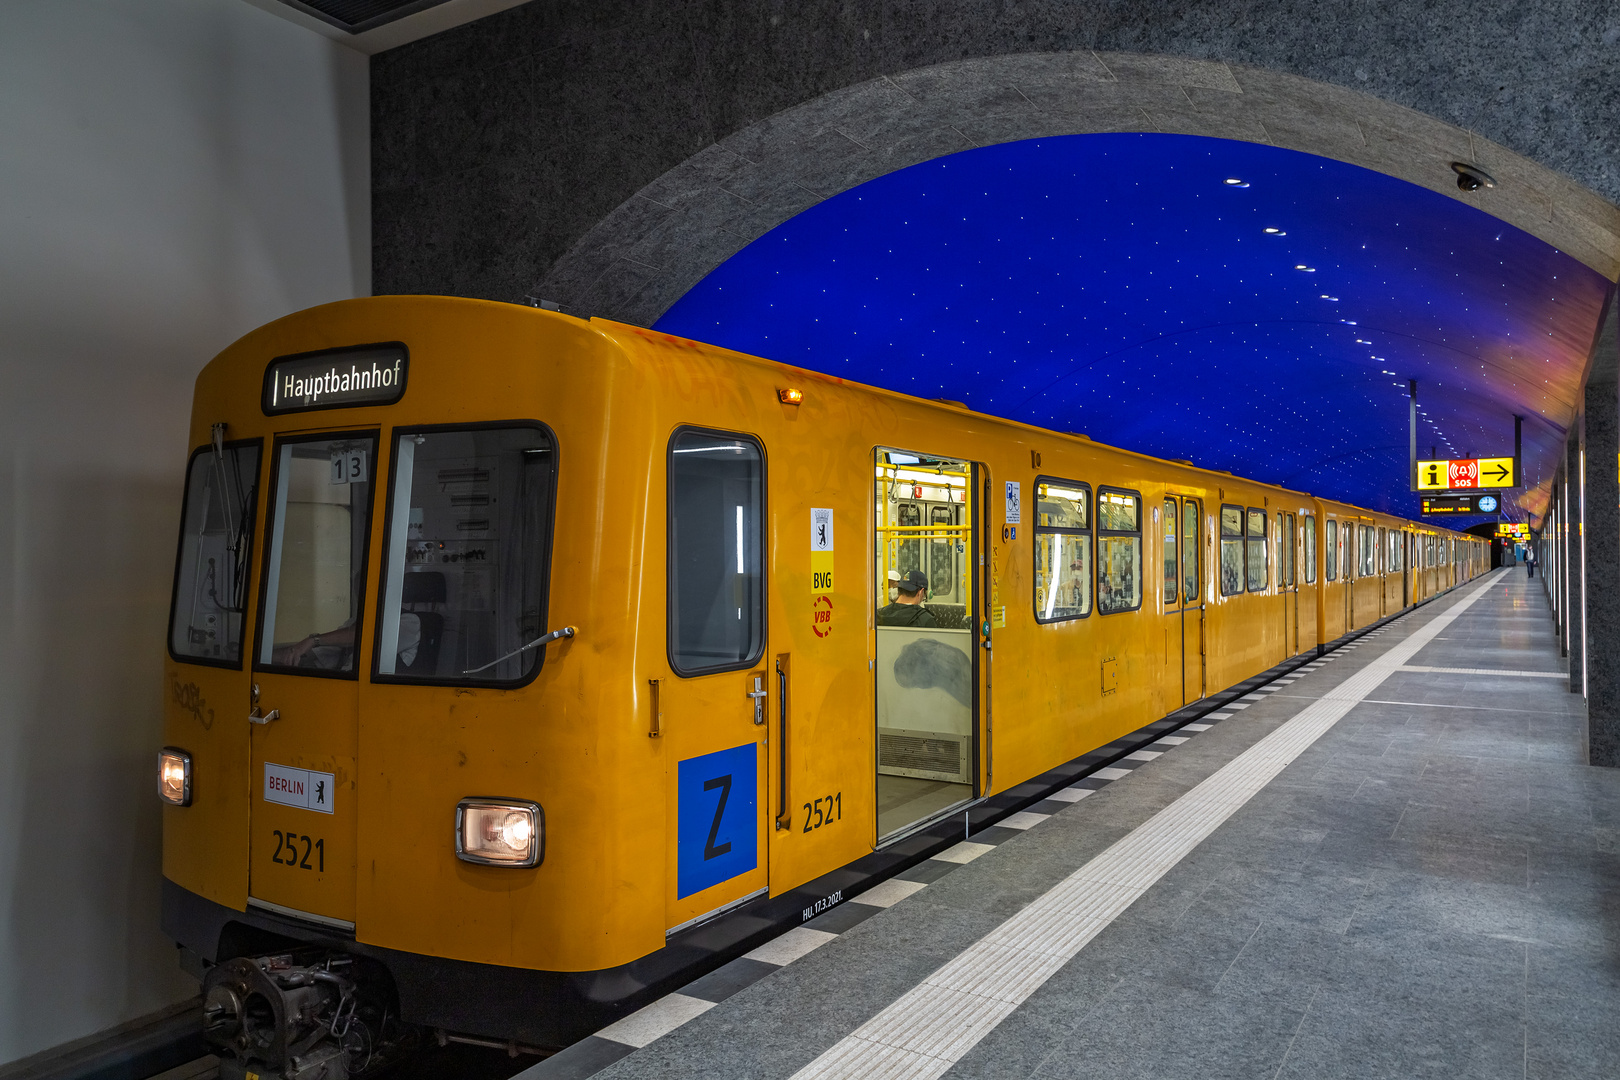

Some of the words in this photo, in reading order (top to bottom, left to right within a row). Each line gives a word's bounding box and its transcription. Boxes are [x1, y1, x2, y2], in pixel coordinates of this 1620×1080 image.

[283, 359, 401, 401] Hauptbahnhof
[1454, 479, 1472, 487] SOS
[813, 571, 832, 589] BVG
[814, 610, 831, 624] VBB
[269, 776, 304, 795] BERLIN
[703, 773, 732, 861] Z
[803, 791, 842, 834] 2521
[272, 829, 324, 872] 2521
